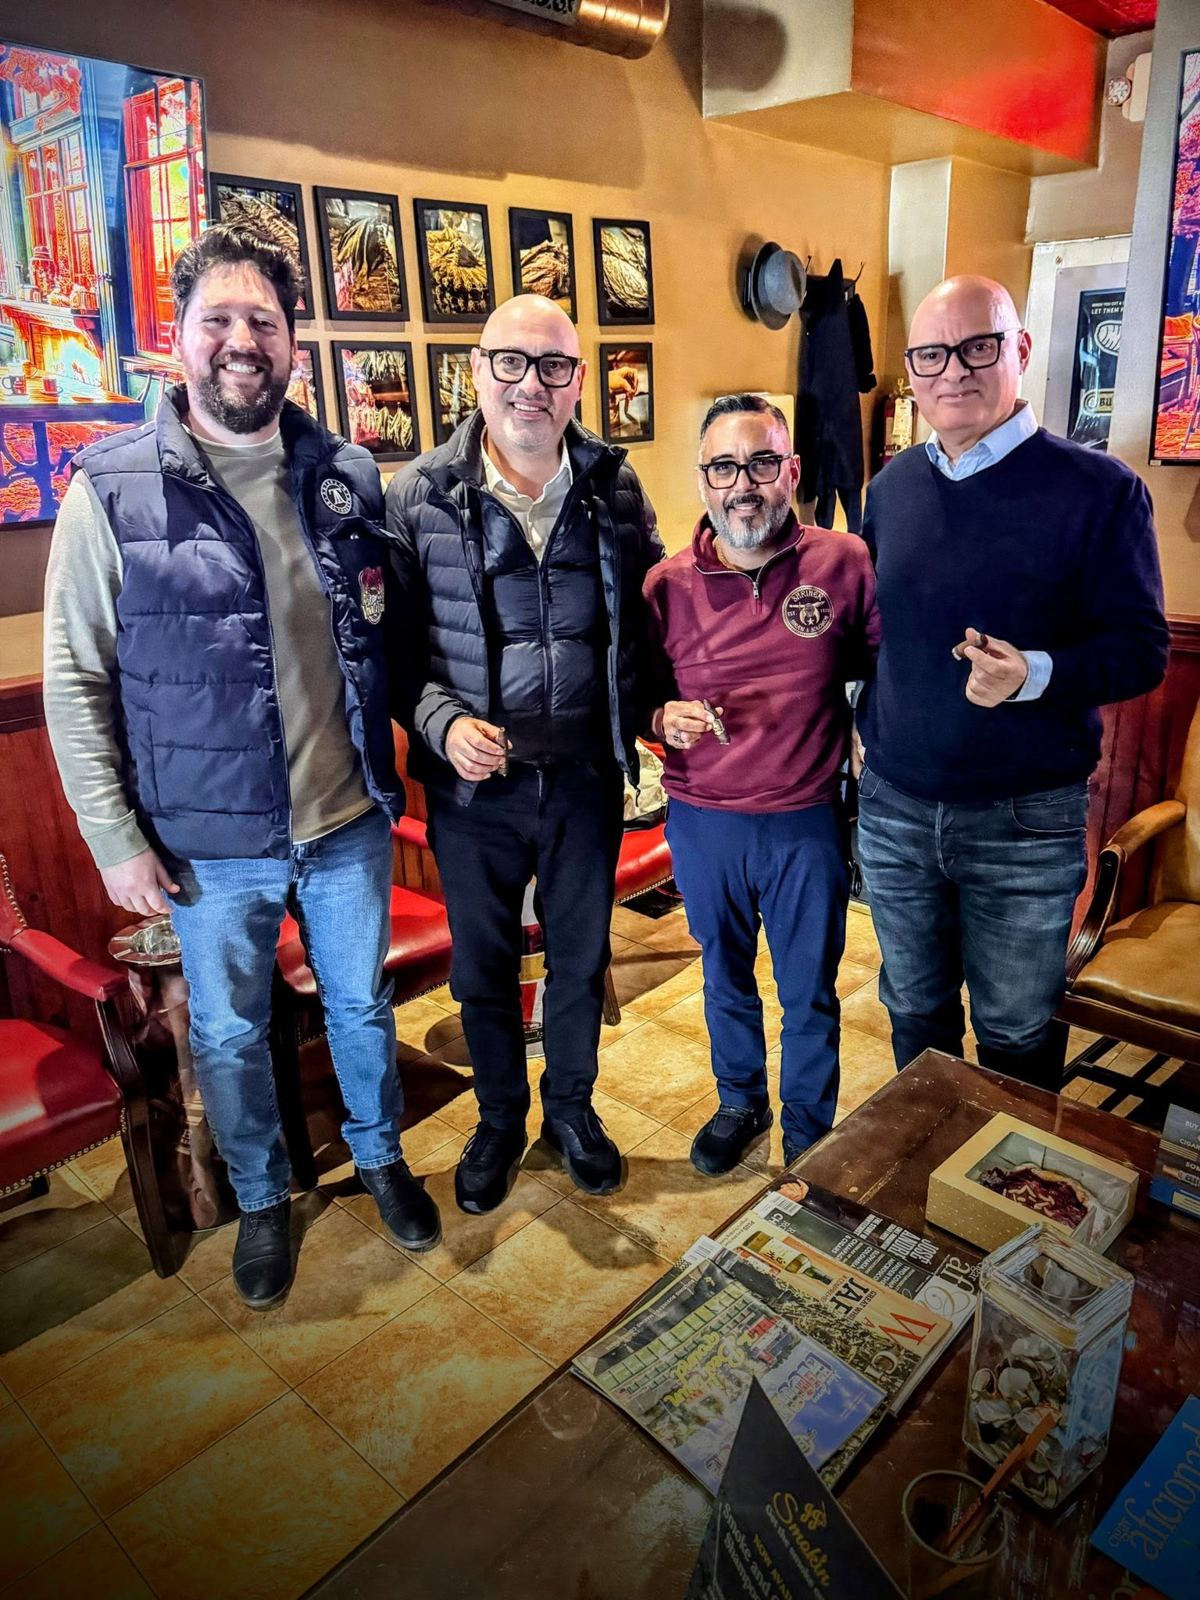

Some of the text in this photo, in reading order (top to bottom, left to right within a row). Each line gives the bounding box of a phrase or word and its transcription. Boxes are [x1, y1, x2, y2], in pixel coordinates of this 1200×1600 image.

[791, 590, 823, 602] SHRINER
[1185, 1120, 1199, 1129] BUY
[908, 1238, 939, 1263] JOSÉ
[857, 1289, 877, 1309] GREAT
[879, 1312, 938, 1347] W
[722, 1502, 752, 1562] Smoke
[750, 1560, 772, 1597] and
[772, 1491, 830, 1586] Smokin
